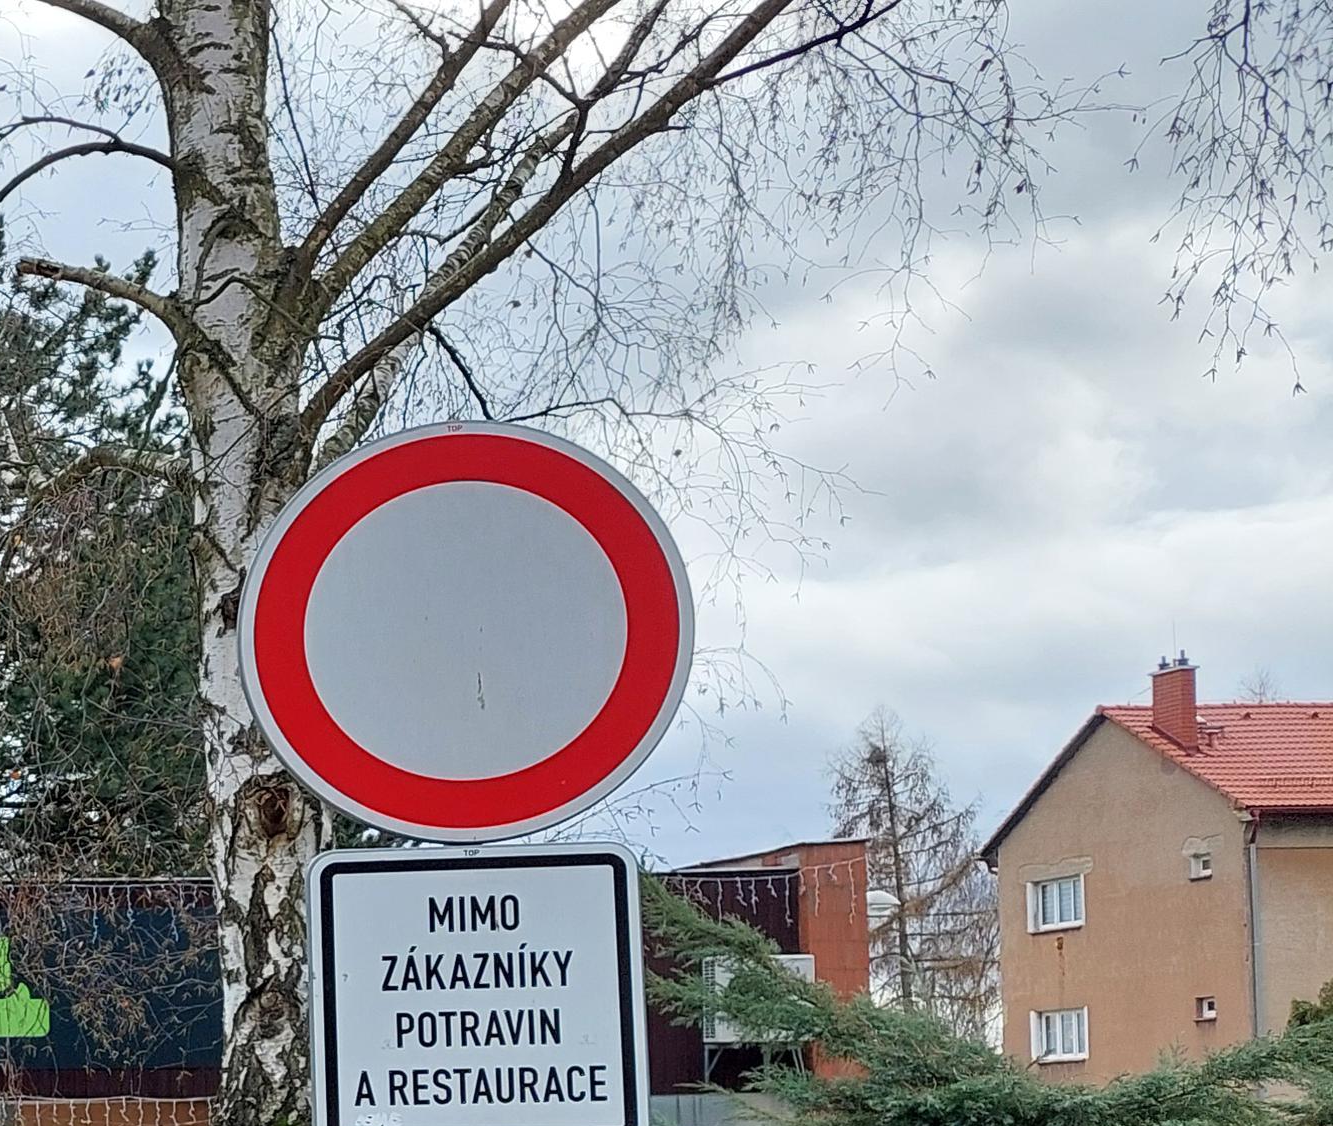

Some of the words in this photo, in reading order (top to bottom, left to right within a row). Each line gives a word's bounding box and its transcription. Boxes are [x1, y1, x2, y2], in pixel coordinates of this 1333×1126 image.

[447, 424, 463, 433] TOP
[463, 849, 481, 857] TOP
[428, 894, 520, 933] MIMO
[381, 942, 574, 992] ZÁKAZNÍKY
[395, 1008, 562, 1049] POTRAVIN
[354, 1070, 377, 1107] A
[388, 1065, 609, 1107] RESTAURACE
